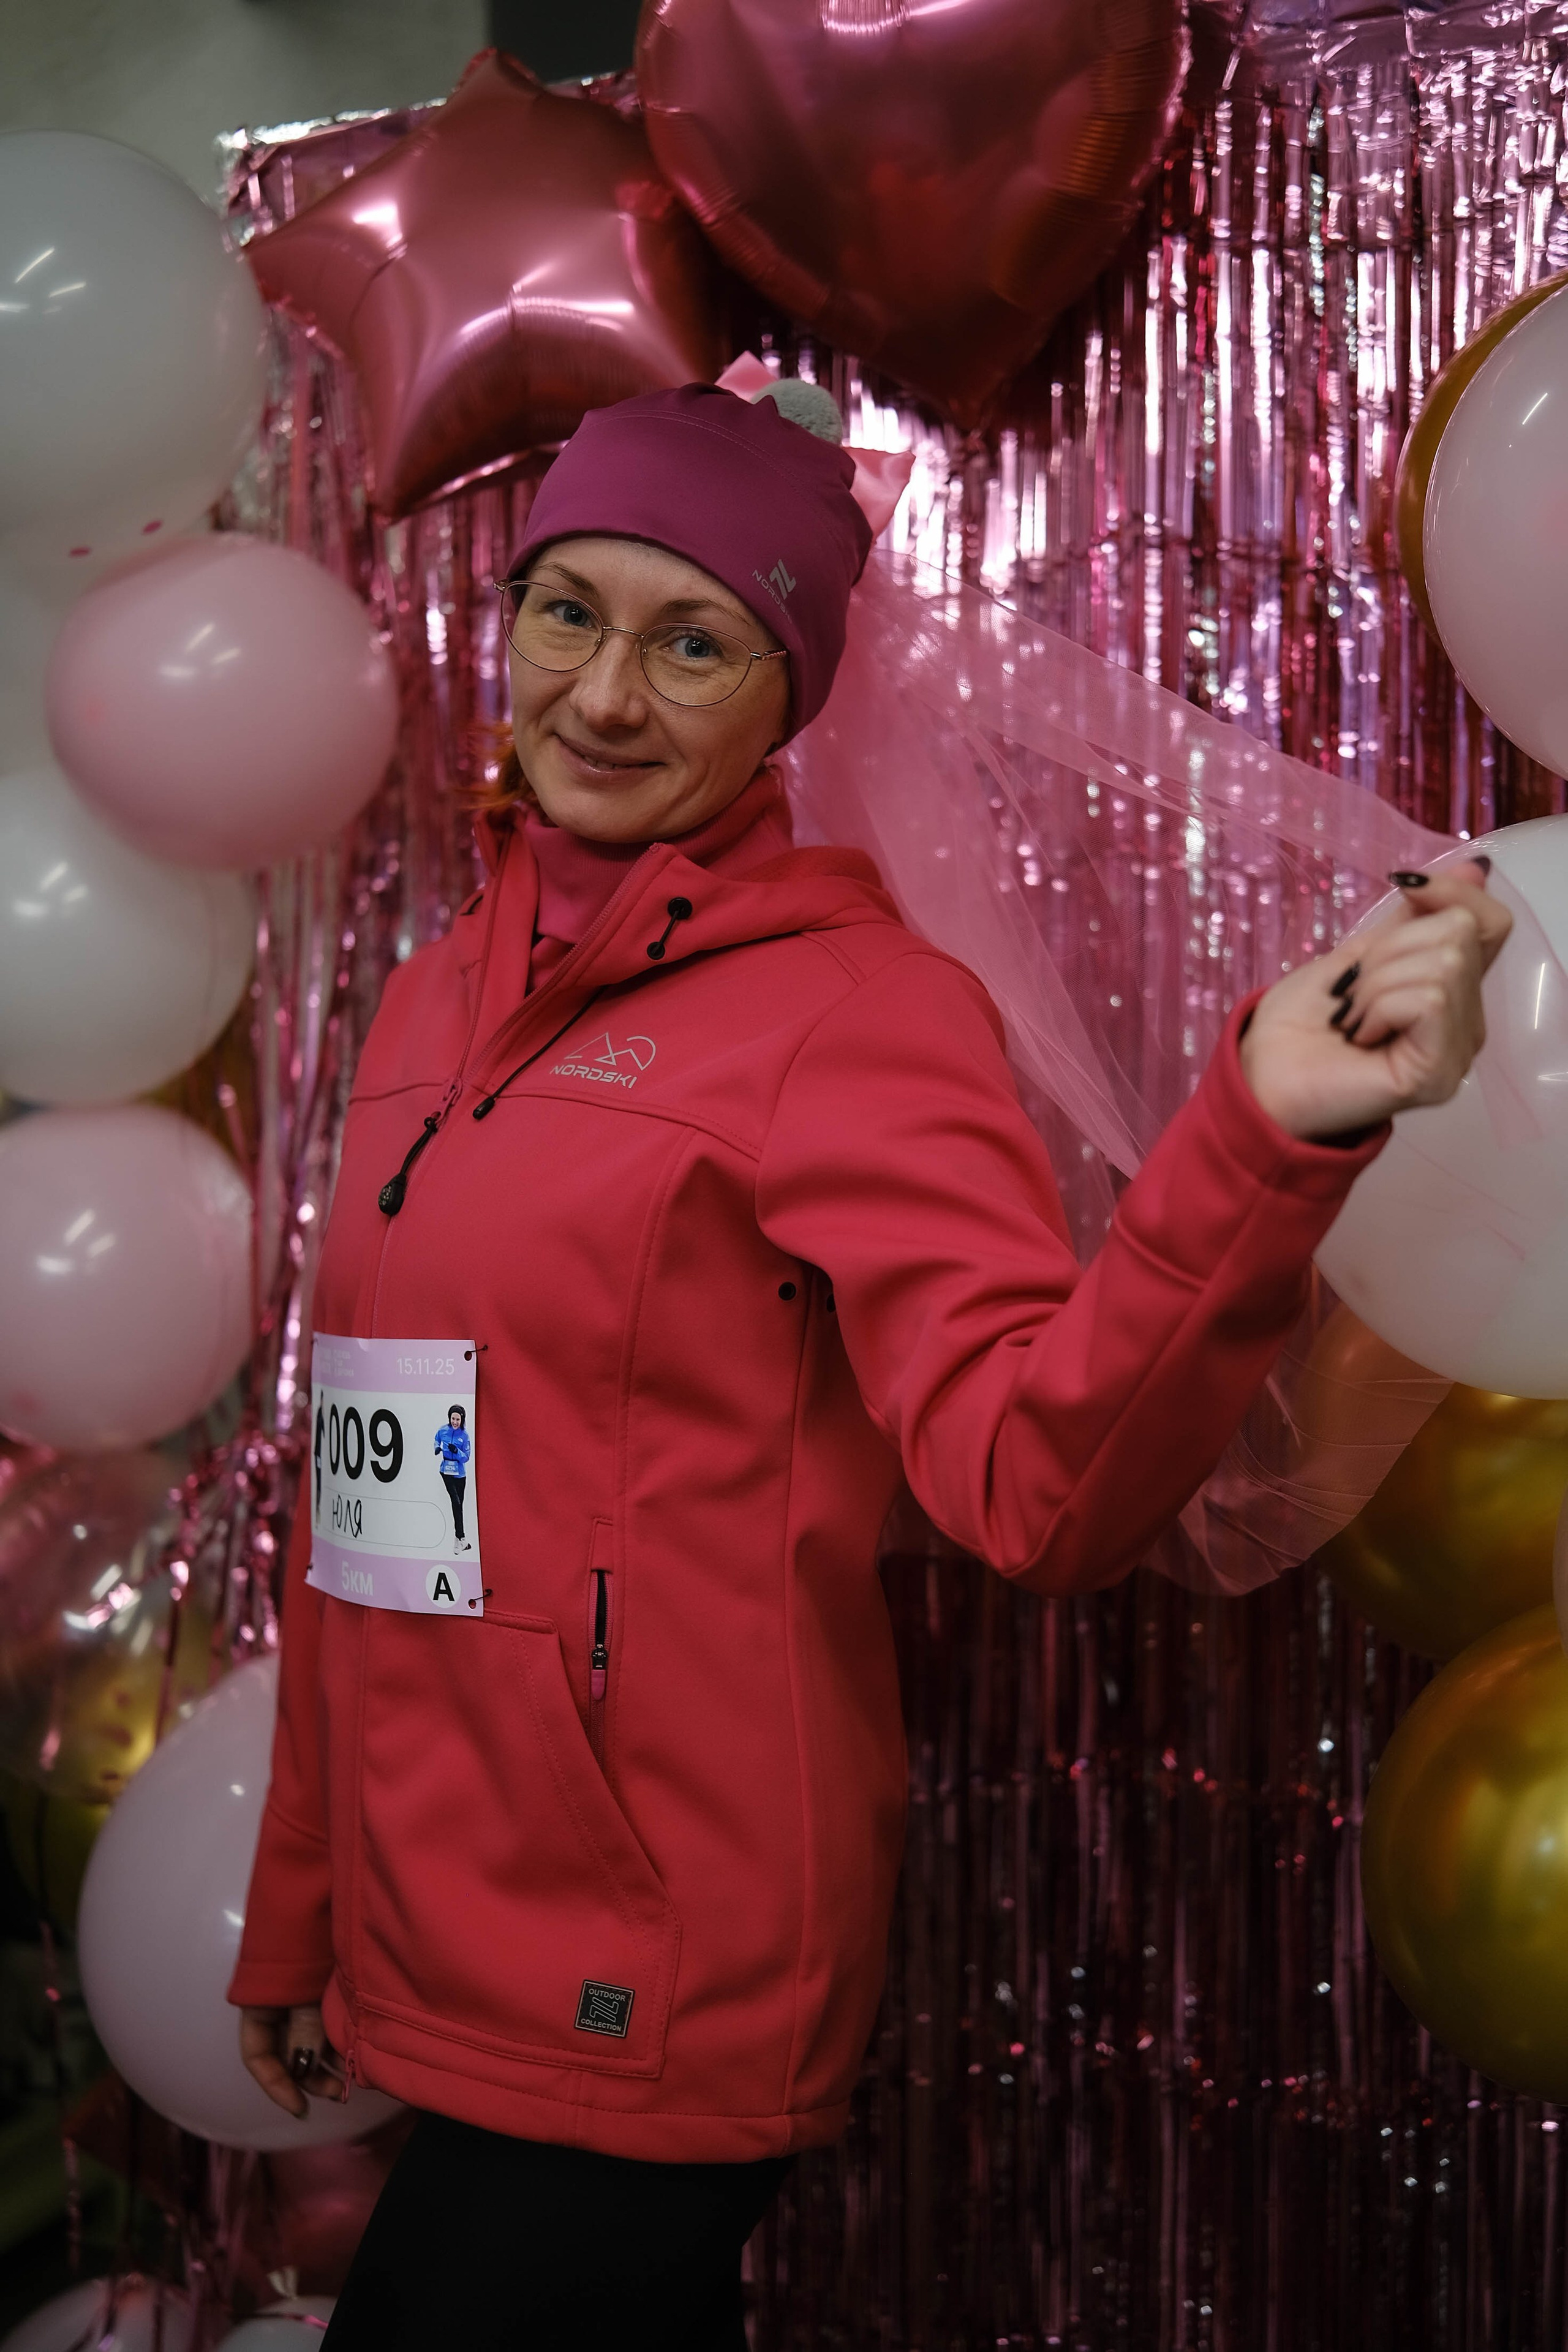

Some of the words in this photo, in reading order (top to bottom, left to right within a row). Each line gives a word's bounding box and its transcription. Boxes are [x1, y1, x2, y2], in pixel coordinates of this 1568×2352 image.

[550, 1064, 638, 1089] NORDSKI
[397, 1358, 455, 1376] 15.11.25
[330, 1403, 404, 1483] 009
[589, 1988, 626, 2002] OUTDOOR
[581, 2018, 622, 2032] COLLECTION
